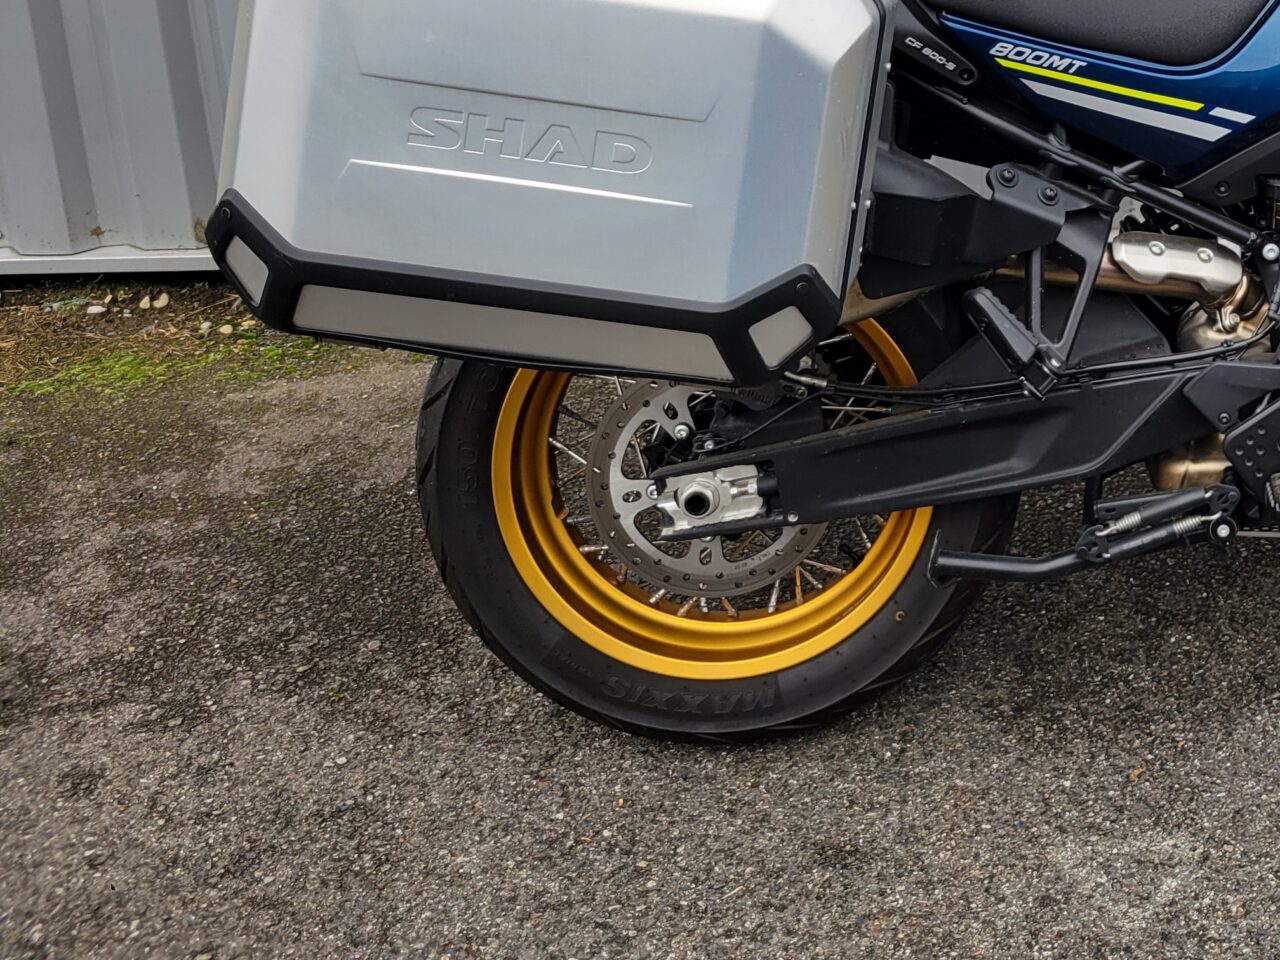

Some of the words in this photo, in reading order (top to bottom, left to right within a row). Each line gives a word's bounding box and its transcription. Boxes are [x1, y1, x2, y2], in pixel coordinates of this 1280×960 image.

[904, 36, 921, 50] CF
[920, 46, 957, 72] 800-S
[989, 42, 1088, 75] 800MT
[406, 105, 654, 175] SHAD
[601, 672, 777, 715] MAXXIS
